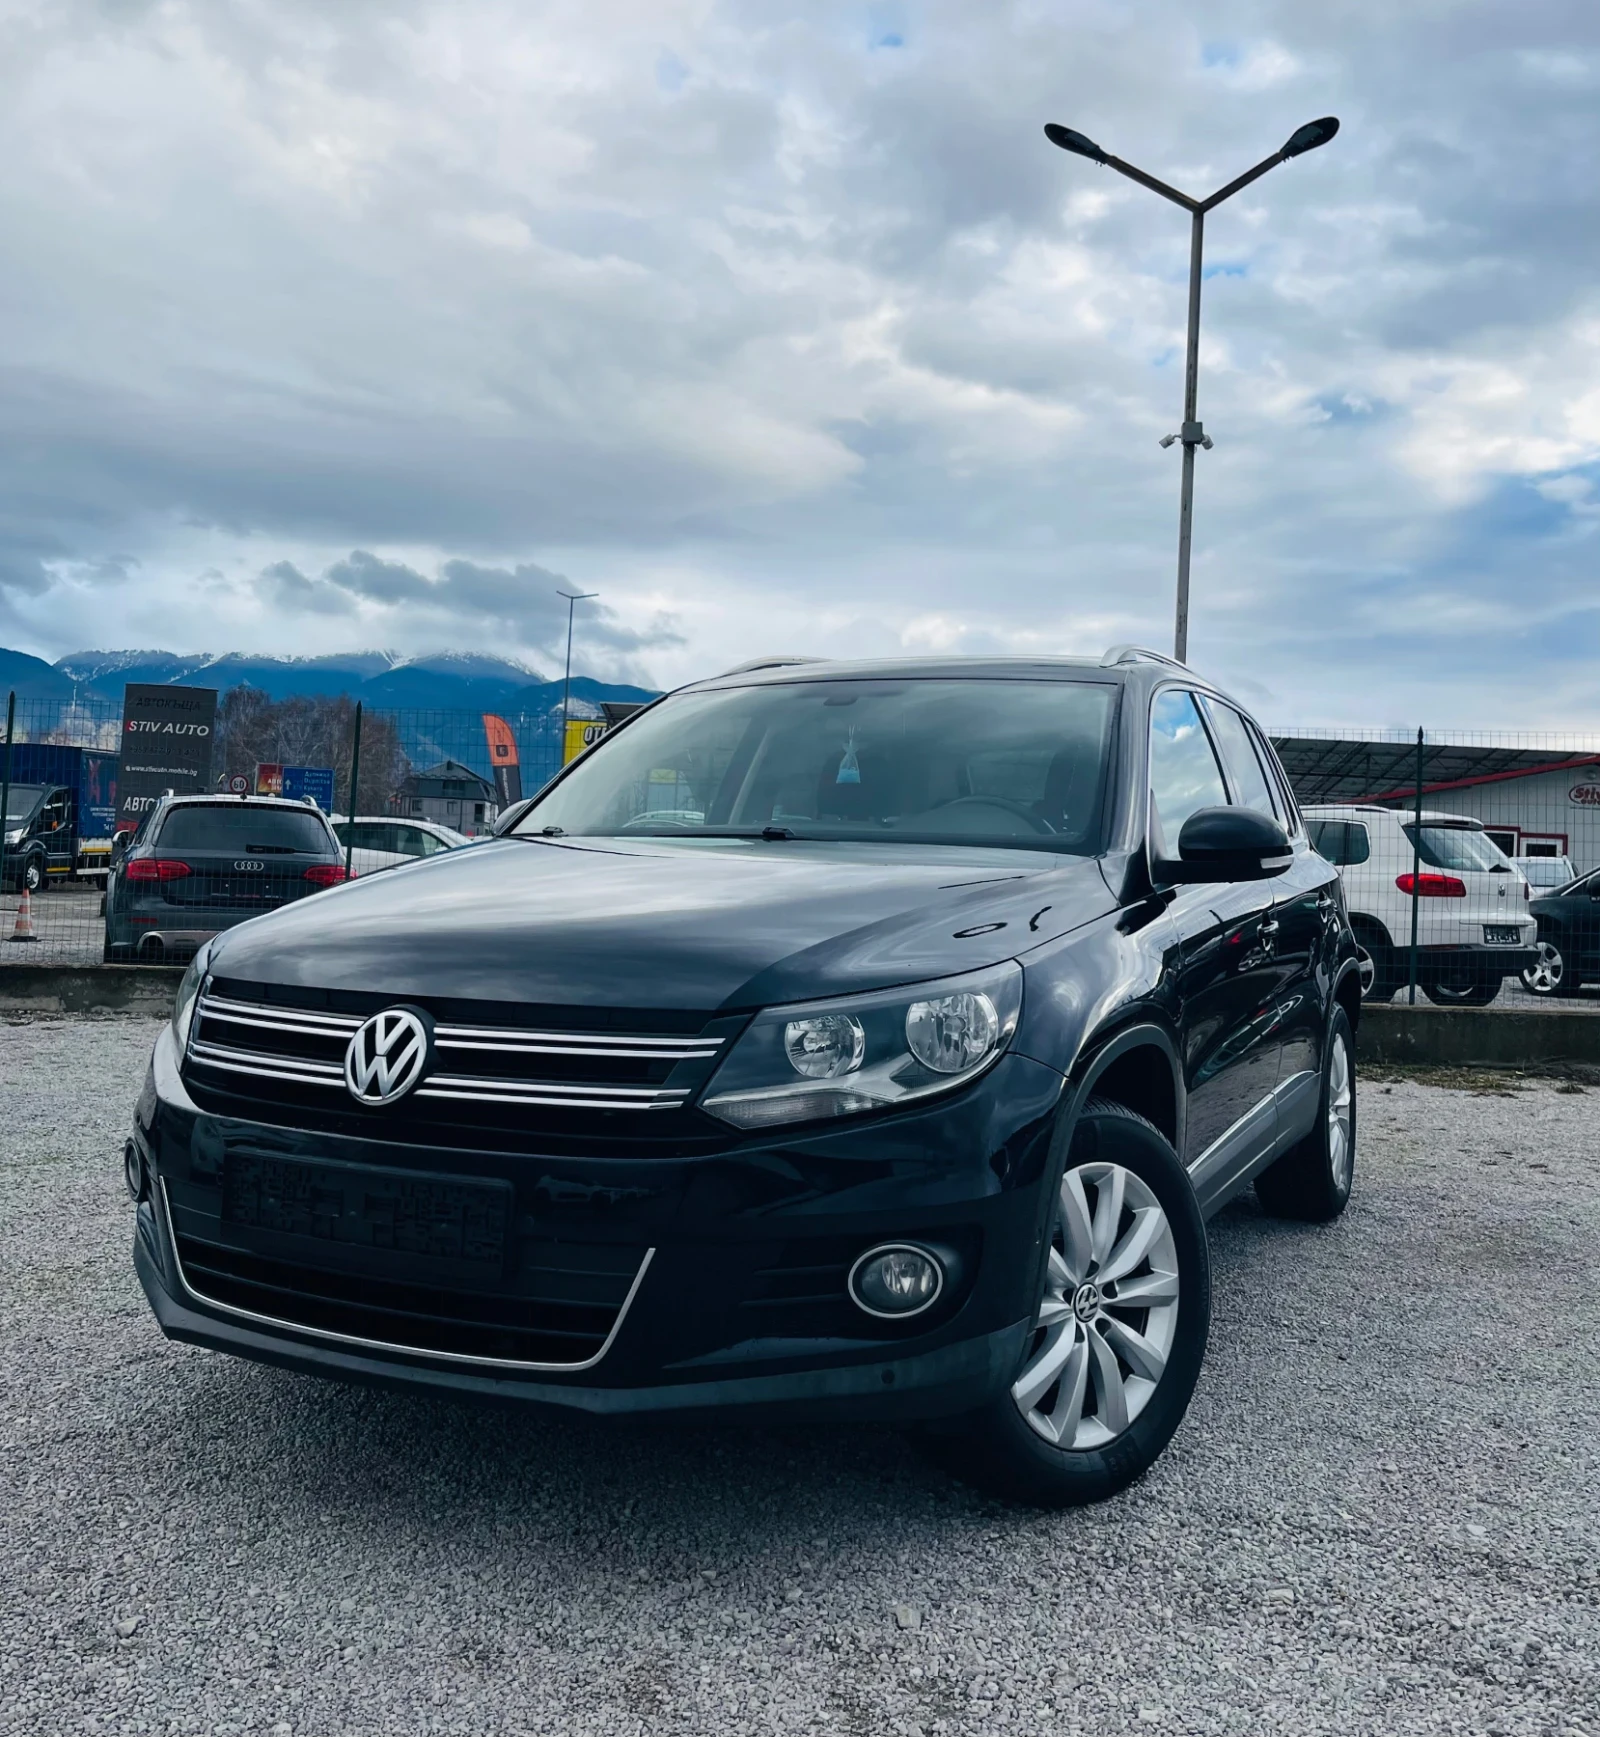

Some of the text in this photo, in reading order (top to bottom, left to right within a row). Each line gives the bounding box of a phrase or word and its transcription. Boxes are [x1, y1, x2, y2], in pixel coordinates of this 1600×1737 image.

[128, 720, 210, 736] STIV AUTO
[233, 781, 245, 789] 60
